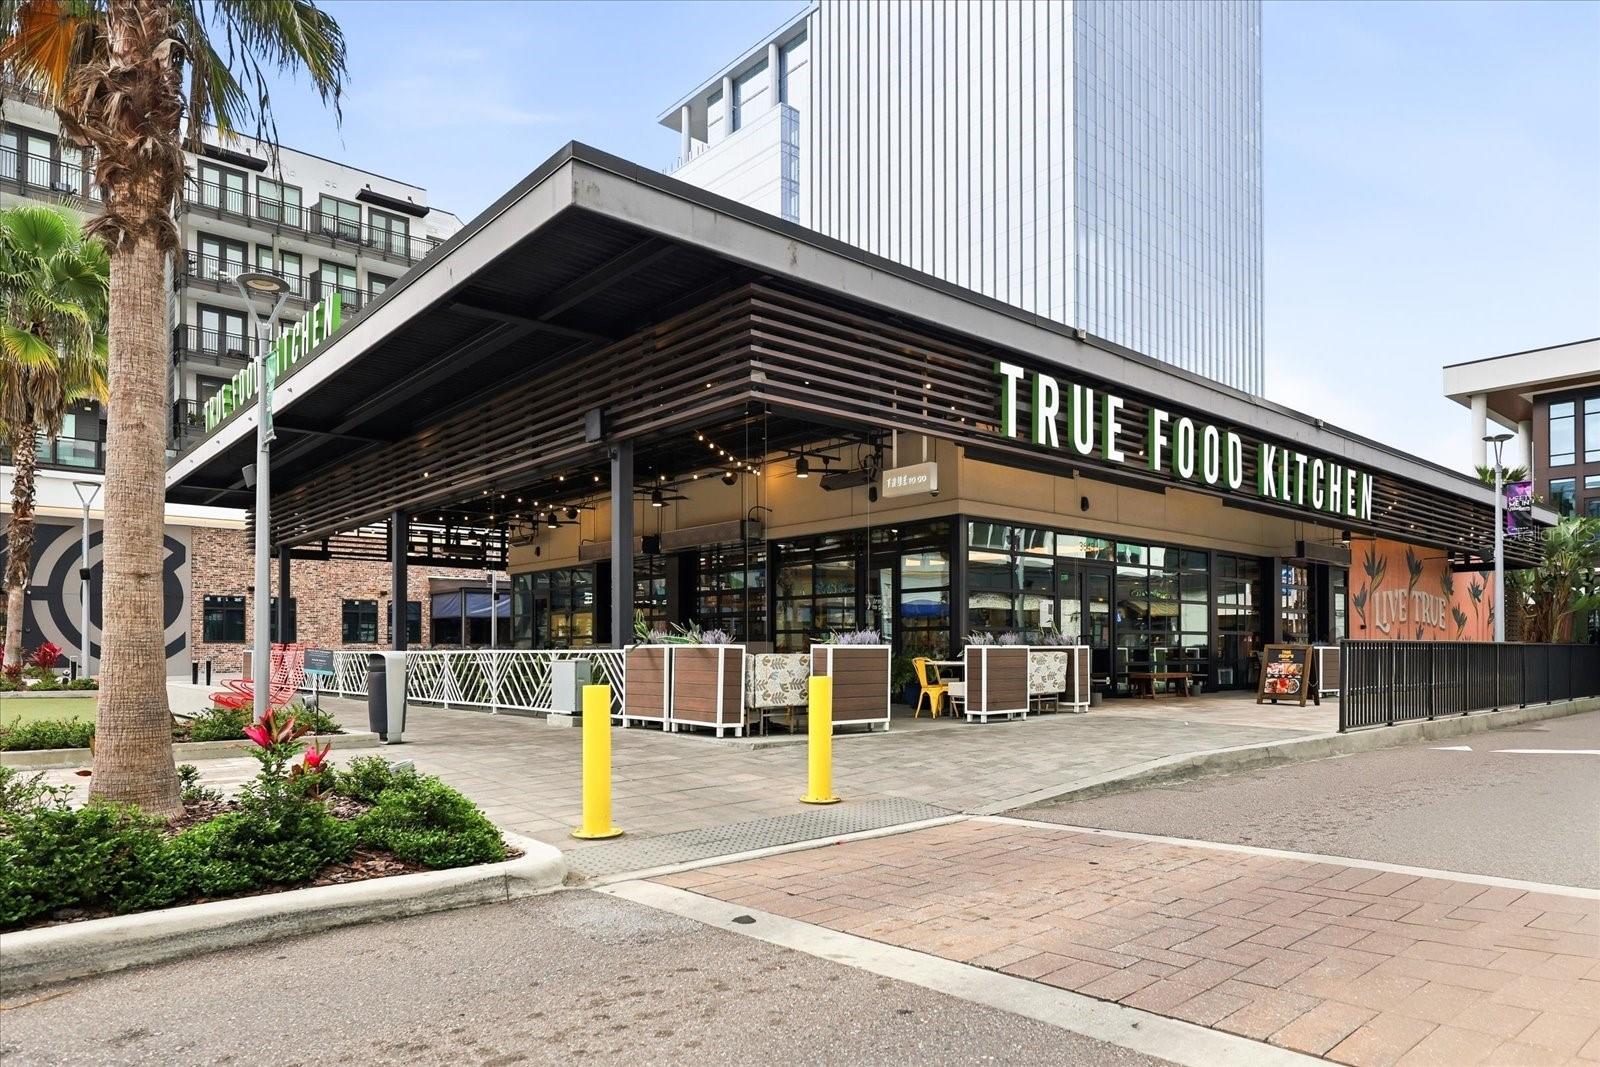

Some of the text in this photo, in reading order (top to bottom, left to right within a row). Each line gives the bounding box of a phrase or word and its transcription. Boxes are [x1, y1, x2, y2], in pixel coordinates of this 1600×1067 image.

[203, 384, 232, 433] TRUE
[269, 291, 341, 376] ITCHEN
[995, 361, 1373, 521] TRUE FOOD KITCHEN
[1371, 590, 1447, 634] LIVE TRUE
